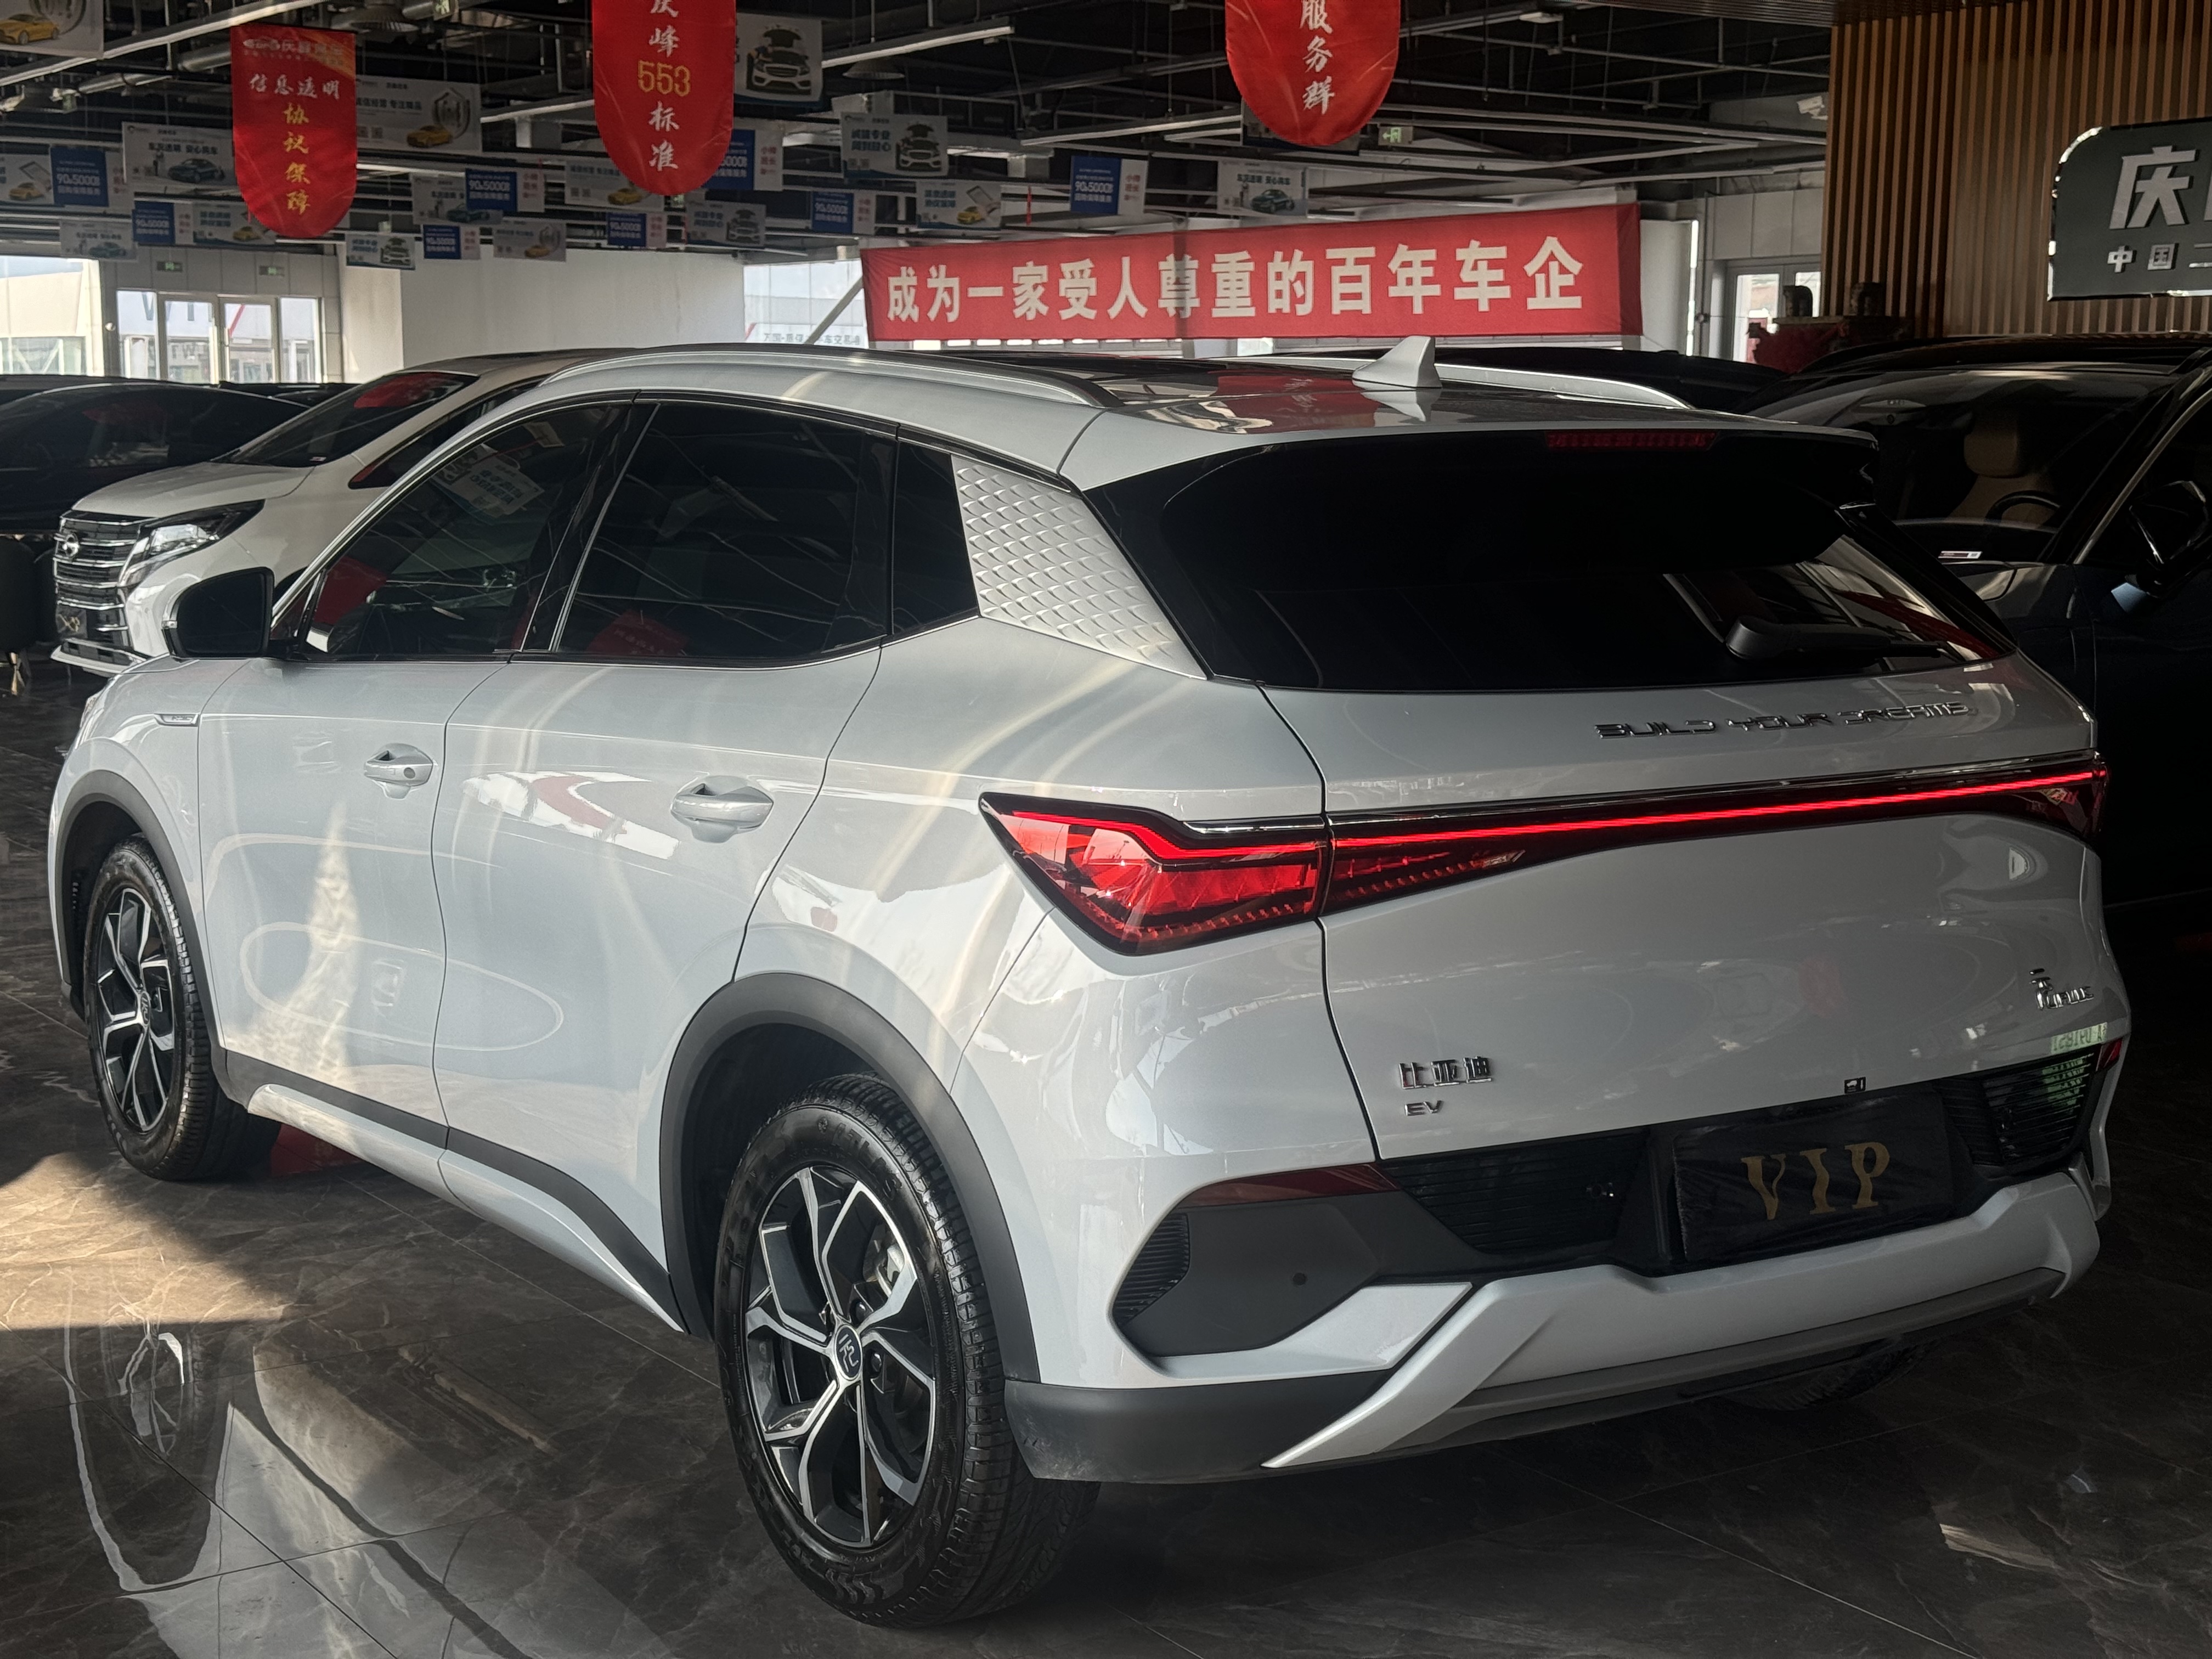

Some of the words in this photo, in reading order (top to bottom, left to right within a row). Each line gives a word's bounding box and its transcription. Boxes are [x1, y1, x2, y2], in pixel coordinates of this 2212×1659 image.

[250, 73, 340, 100] 信息透明
[887, 235, 1584, 321] 成为一家受人尊重的百年车企
[1594, 720, 1716, 740] BUILD
[1725, 713, 1831, 731] YOUR
[1837, 701, 1970, 725] DREAMS
[1398, 1056, 1493, 1090] 比亚迪
[1403, 1099, 1444, 1116] EV
[1740, 1141, 1891, 1221] VIP
